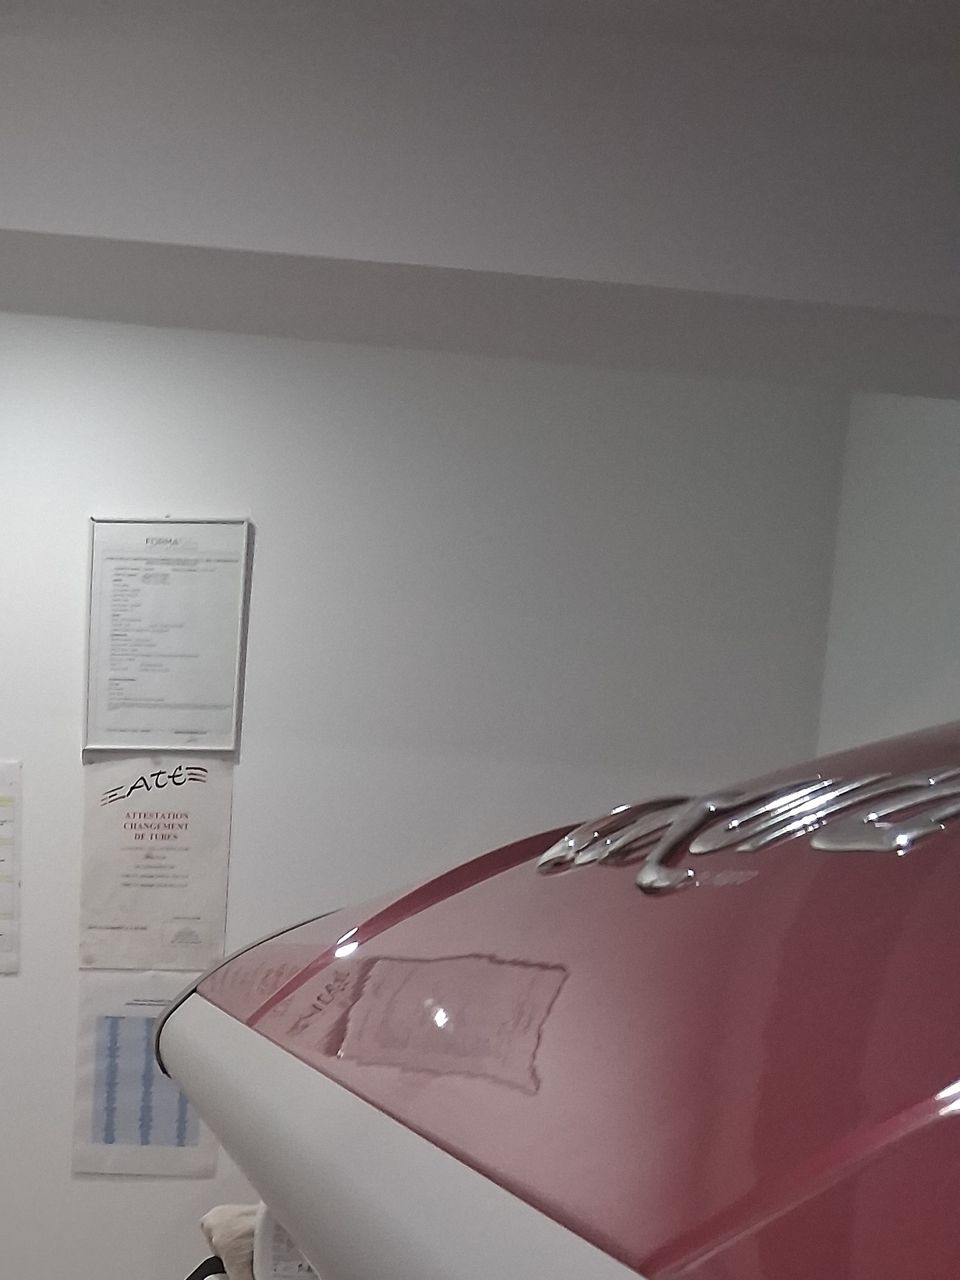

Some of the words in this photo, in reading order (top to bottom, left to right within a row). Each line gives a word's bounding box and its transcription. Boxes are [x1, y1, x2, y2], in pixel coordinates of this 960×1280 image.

[124, 812, 189, 820] ATTESTATION
[122, 822, 189, 830] CHANGEMENT
[133, 833, 145, 841] DE
[149, 833, 178, 841] TUBES
